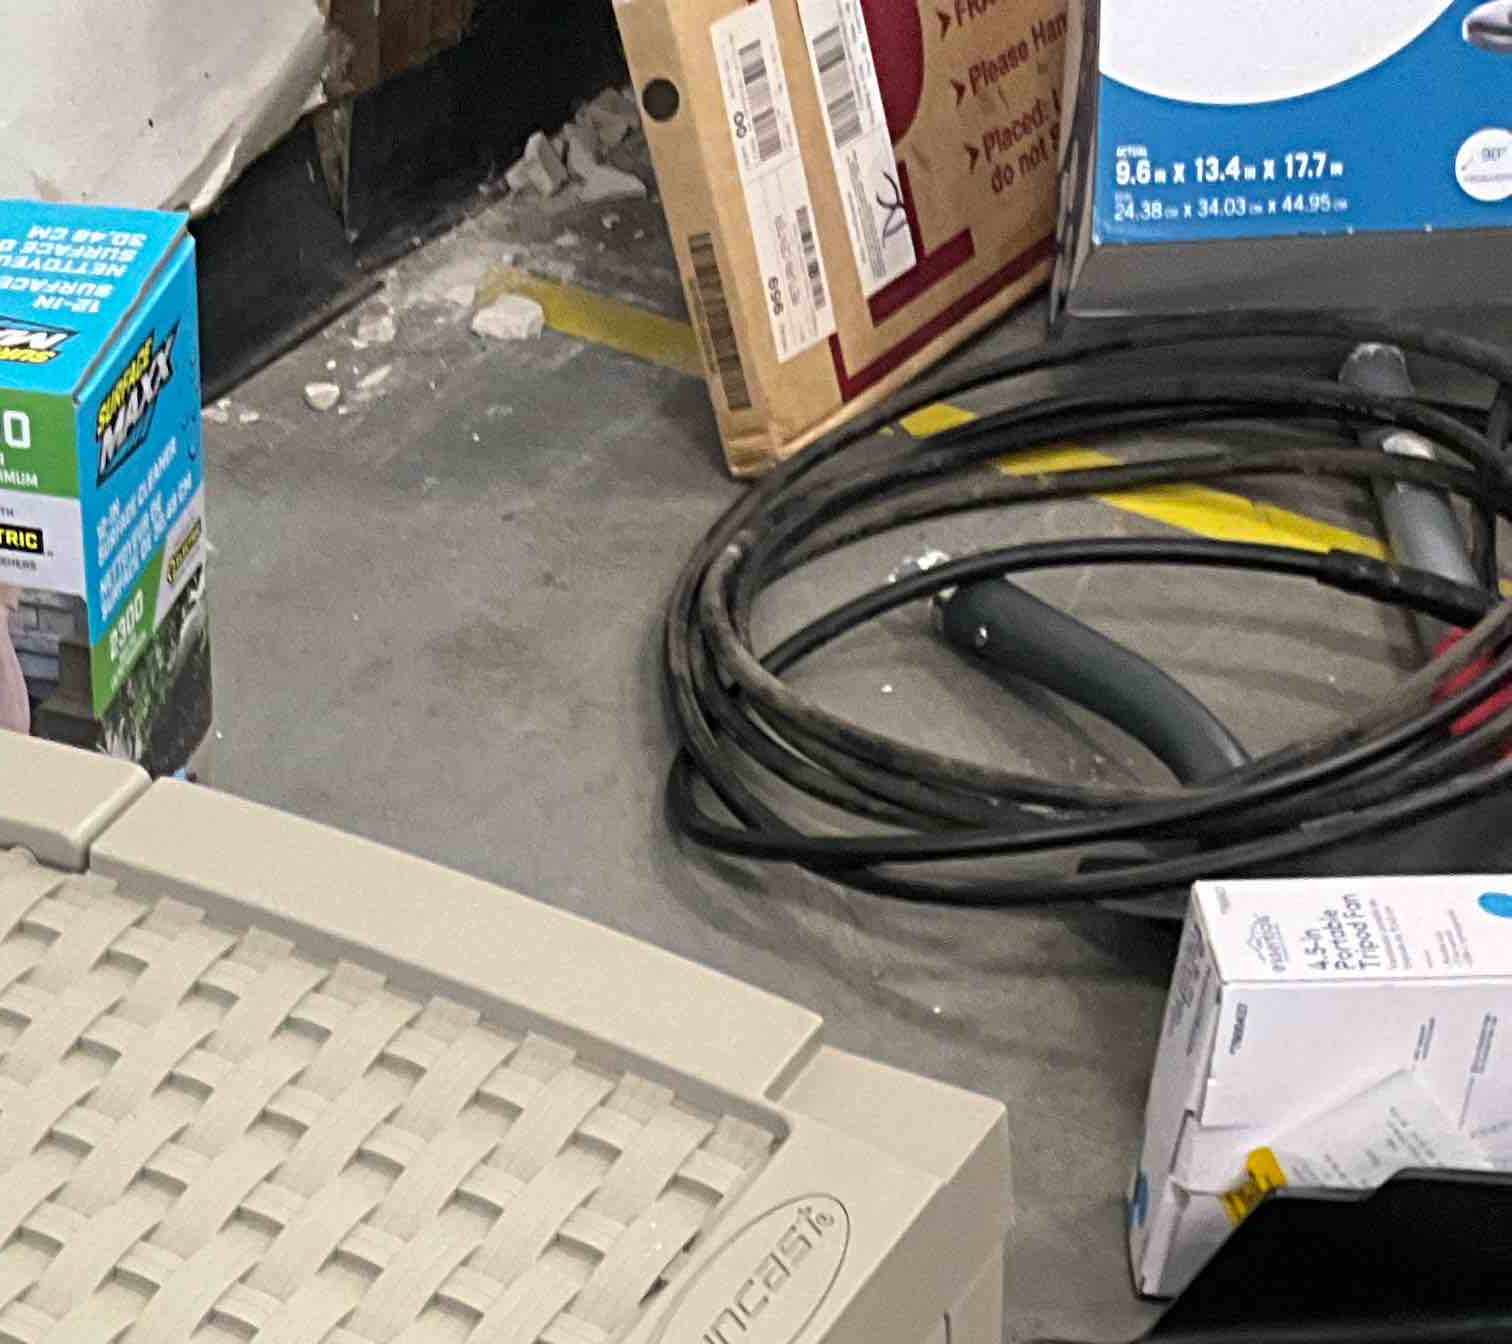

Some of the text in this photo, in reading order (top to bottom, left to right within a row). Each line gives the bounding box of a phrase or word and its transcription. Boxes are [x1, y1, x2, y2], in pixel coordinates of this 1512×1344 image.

[968, 40, 1029, 97] Please
[1031, 13, 1067, 53] Han
[991, 163, 1015, 193] do
[1018, 136, 1049, 177] not
[1115, 160, 1152, 186] 9.6
[1195, 155, 1241, 183] 13.4
[1285, 151, 1327, 180] 17.7
[1113, 200, 1162, 222] 24.38
[1197, 196, 1246, 217] 34.03
[1282, 192, 1330, 213] 44.95
[1348, 920, 1381, 970] Tripod
